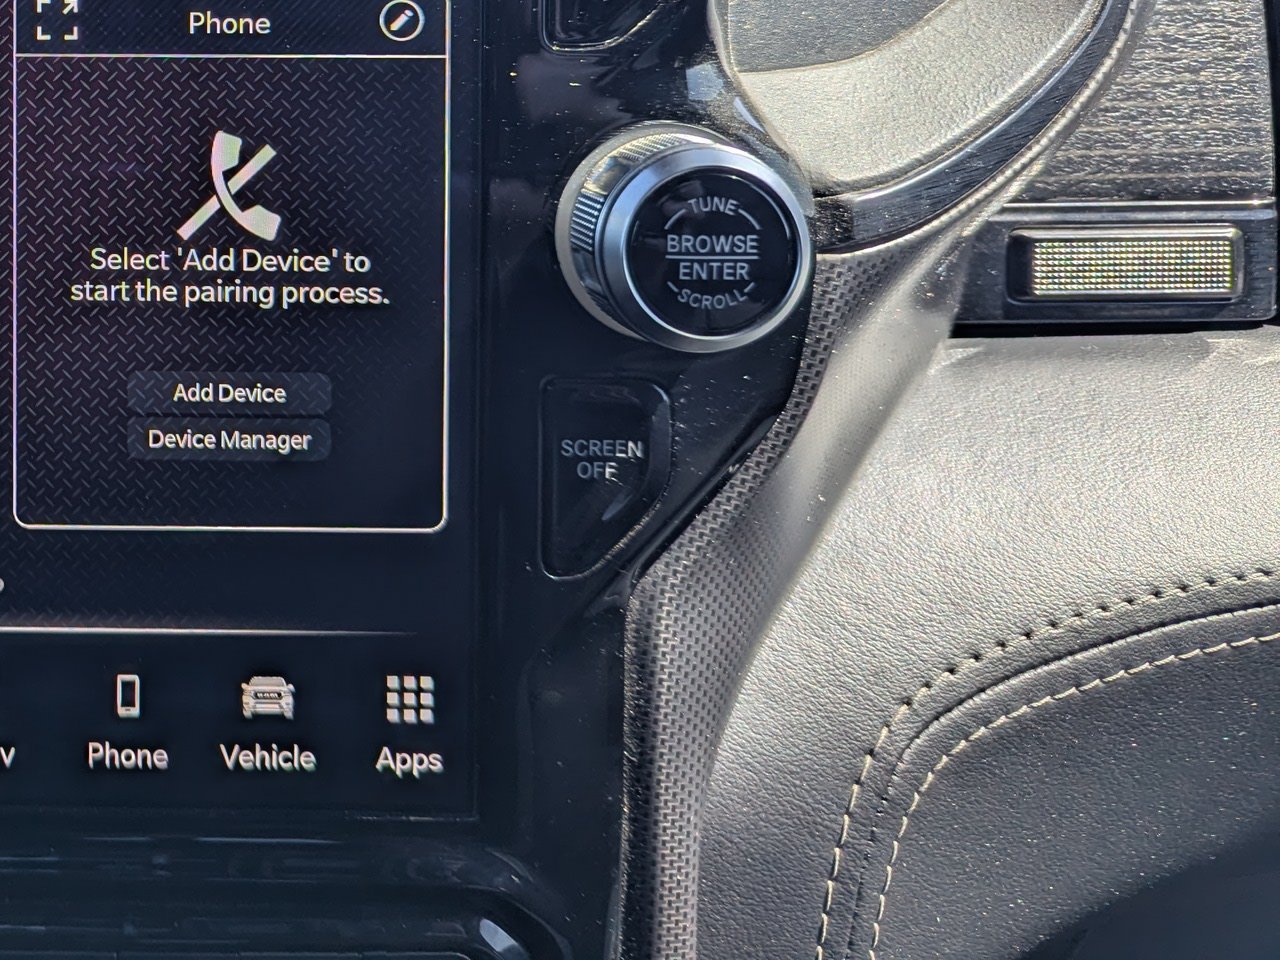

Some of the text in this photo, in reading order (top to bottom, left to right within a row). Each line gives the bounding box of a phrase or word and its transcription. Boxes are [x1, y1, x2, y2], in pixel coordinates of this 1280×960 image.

[188, 11, 272, 35] Phone
[687, 197, 740, 216] TUNE
[666, 235, 760, 254] BROWSE
[89, 248, 372, 274] Select 'Add Device' to
[678, 262, 750, 281] ENTER
[70, 281, 391, 310] start the pairing process.
[677, 288, 747, 310] SCROLL
[173, 384, 287, 403] Add Device
[148, 429, 312, 455] Device Manager
[561, 440, 644, 458] SCREEN
[577, 461, 619, 480] OFF
[88, 742, 169, 771] Phone
[220, 743, 318, 771] Vehicle
[376, 747, 445, 778] Apps
